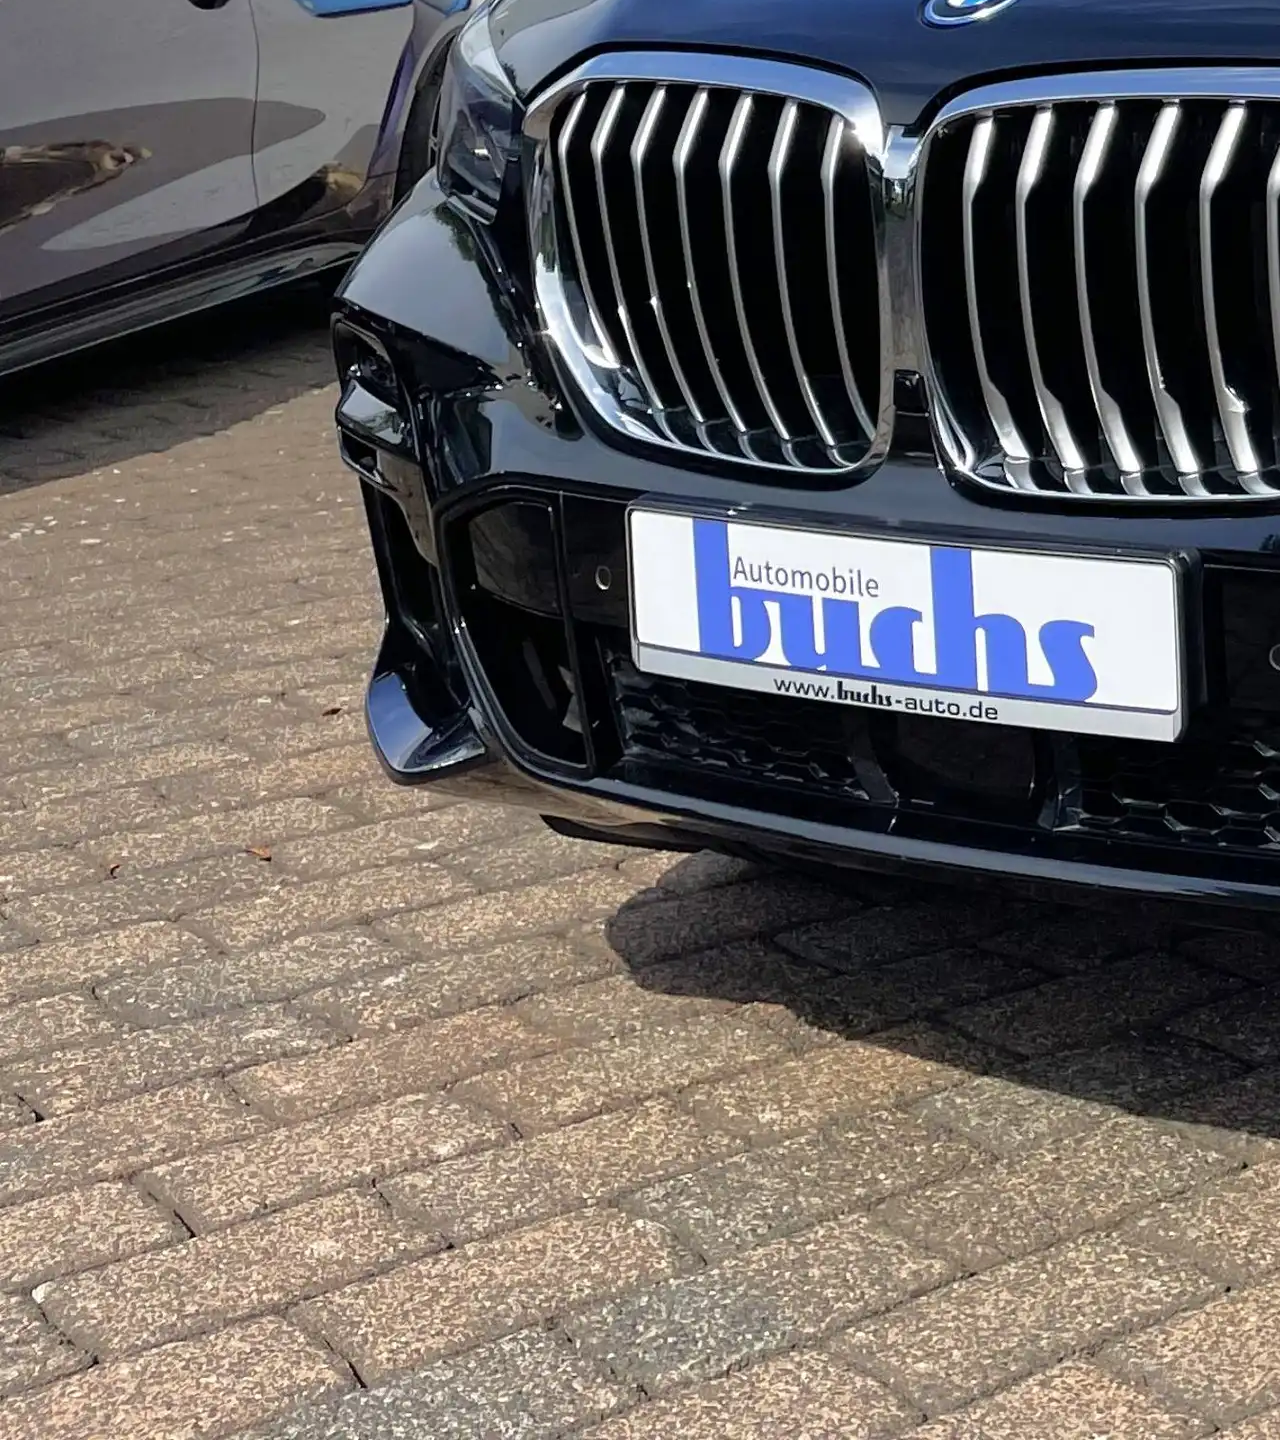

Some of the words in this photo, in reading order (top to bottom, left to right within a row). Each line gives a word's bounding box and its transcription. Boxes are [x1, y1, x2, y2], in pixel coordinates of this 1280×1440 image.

[732, 555, 879, 598] Automobile
[692, 517, 1098, 703] buchs
[773, 679, 998, 720] www.buchs-auto.de
